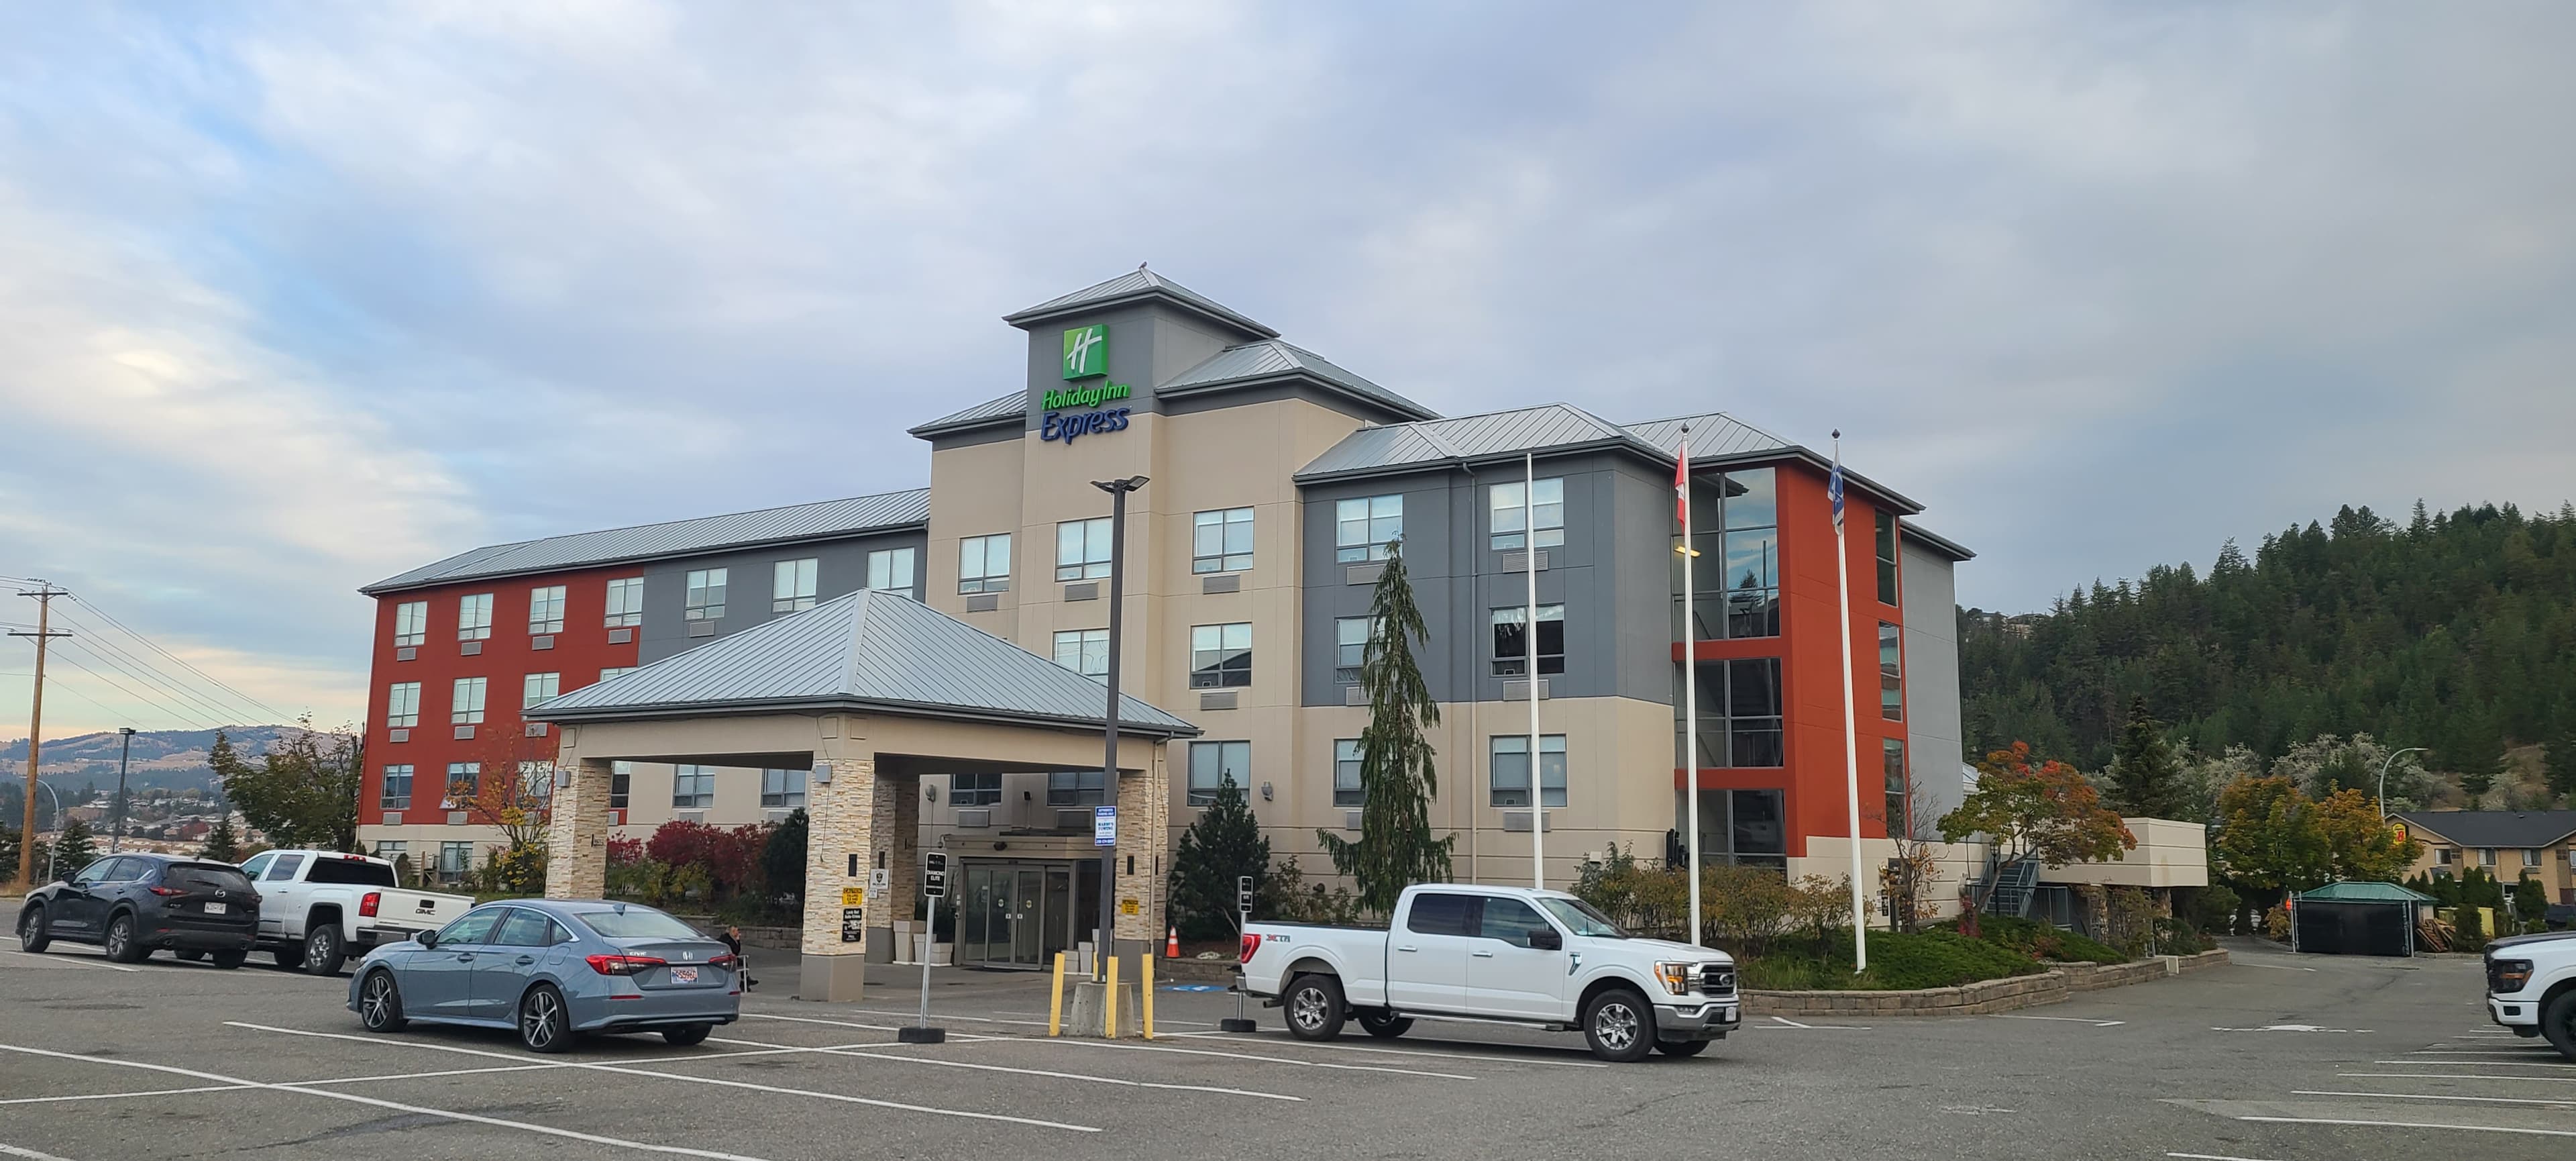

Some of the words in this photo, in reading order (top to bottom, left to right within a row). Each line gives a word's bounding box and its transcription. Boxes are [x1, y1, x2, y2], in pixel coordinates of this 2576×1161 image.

[1041, 385, 1102, 411] Holiday
[1102, 381, 1130, 401] Inn
[1040, 407, 1130, 445] Express
[2397, 831, 2404, 842] 8
